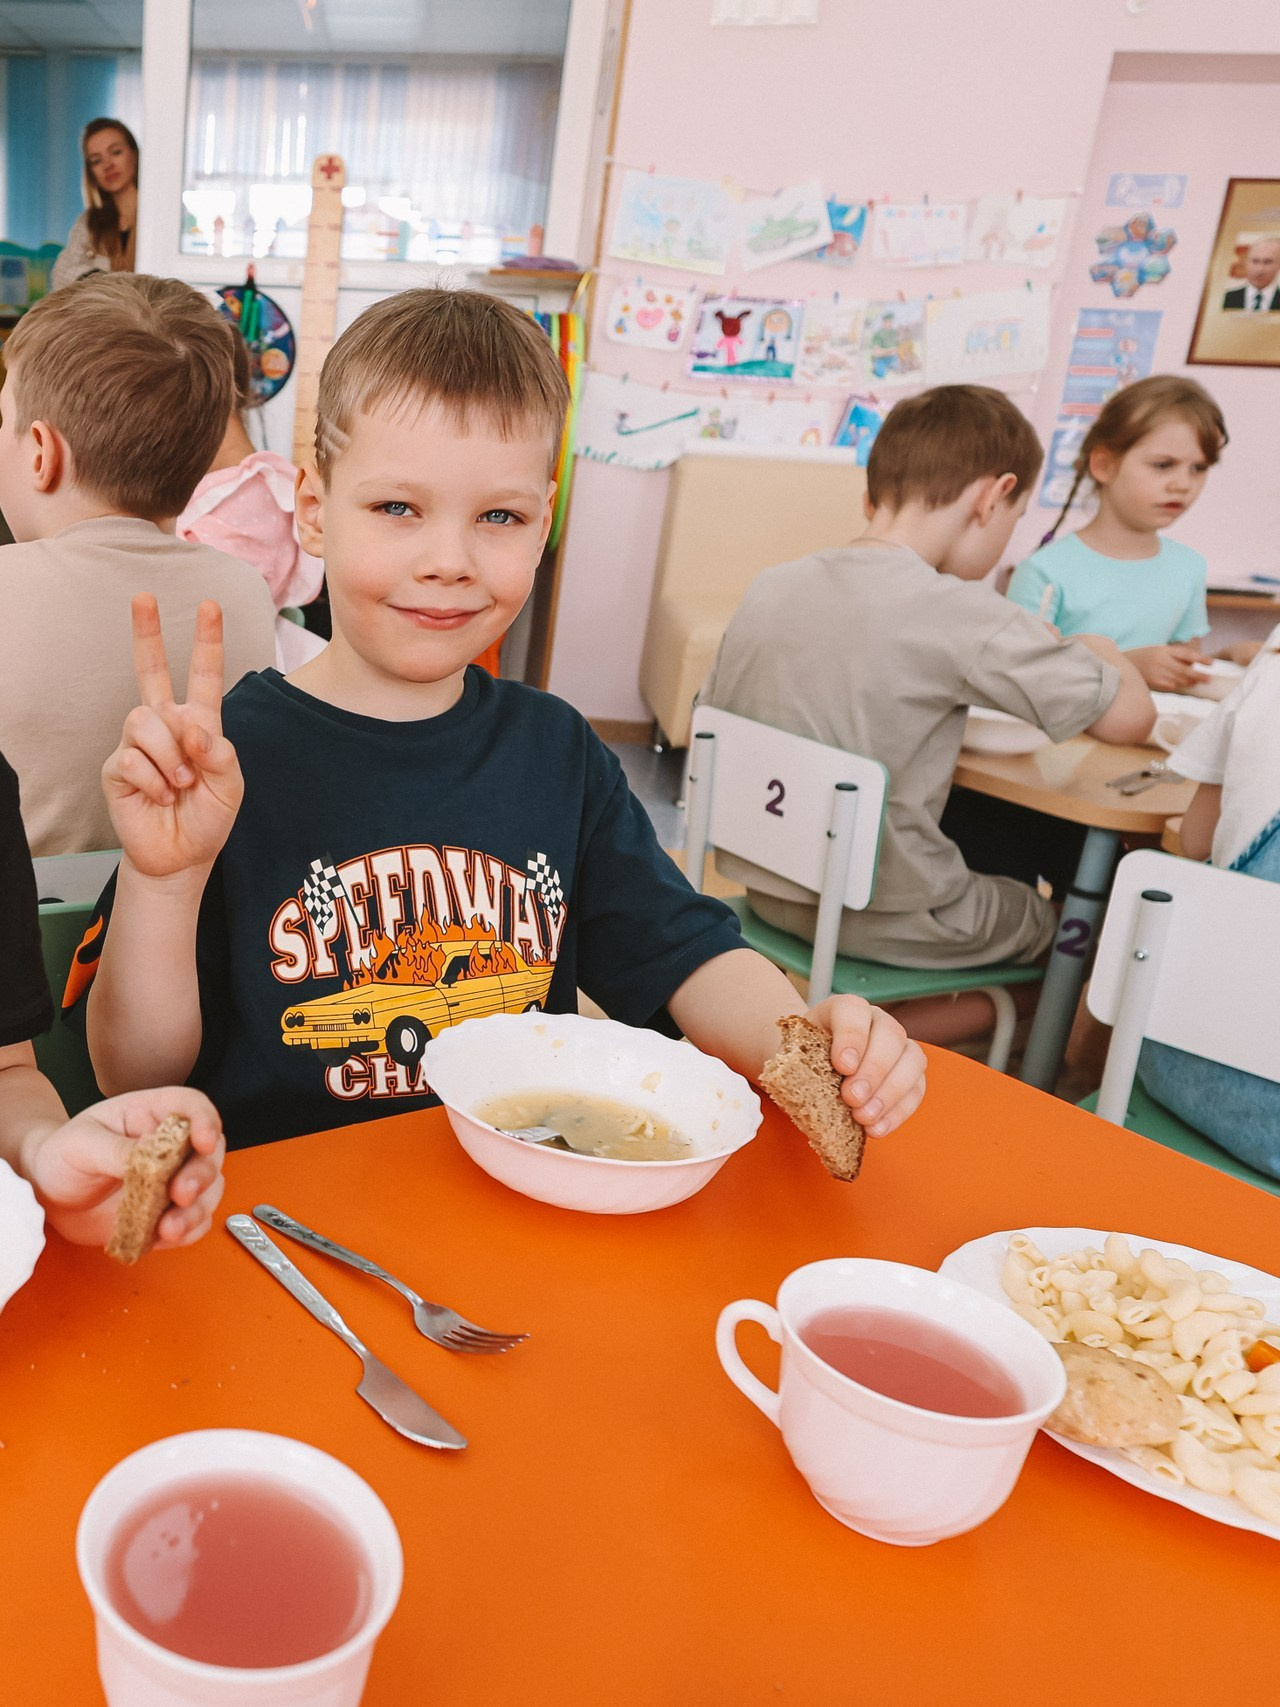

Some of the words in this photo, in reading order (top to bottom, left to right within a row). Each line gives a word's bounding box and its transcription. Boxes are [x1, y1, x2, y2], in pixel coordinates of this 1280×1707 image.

[765, 779, 785, 817] 2
[269, 844, 568, 984] SPEEDWAY
[1056, 918, 1091, 958] 2
